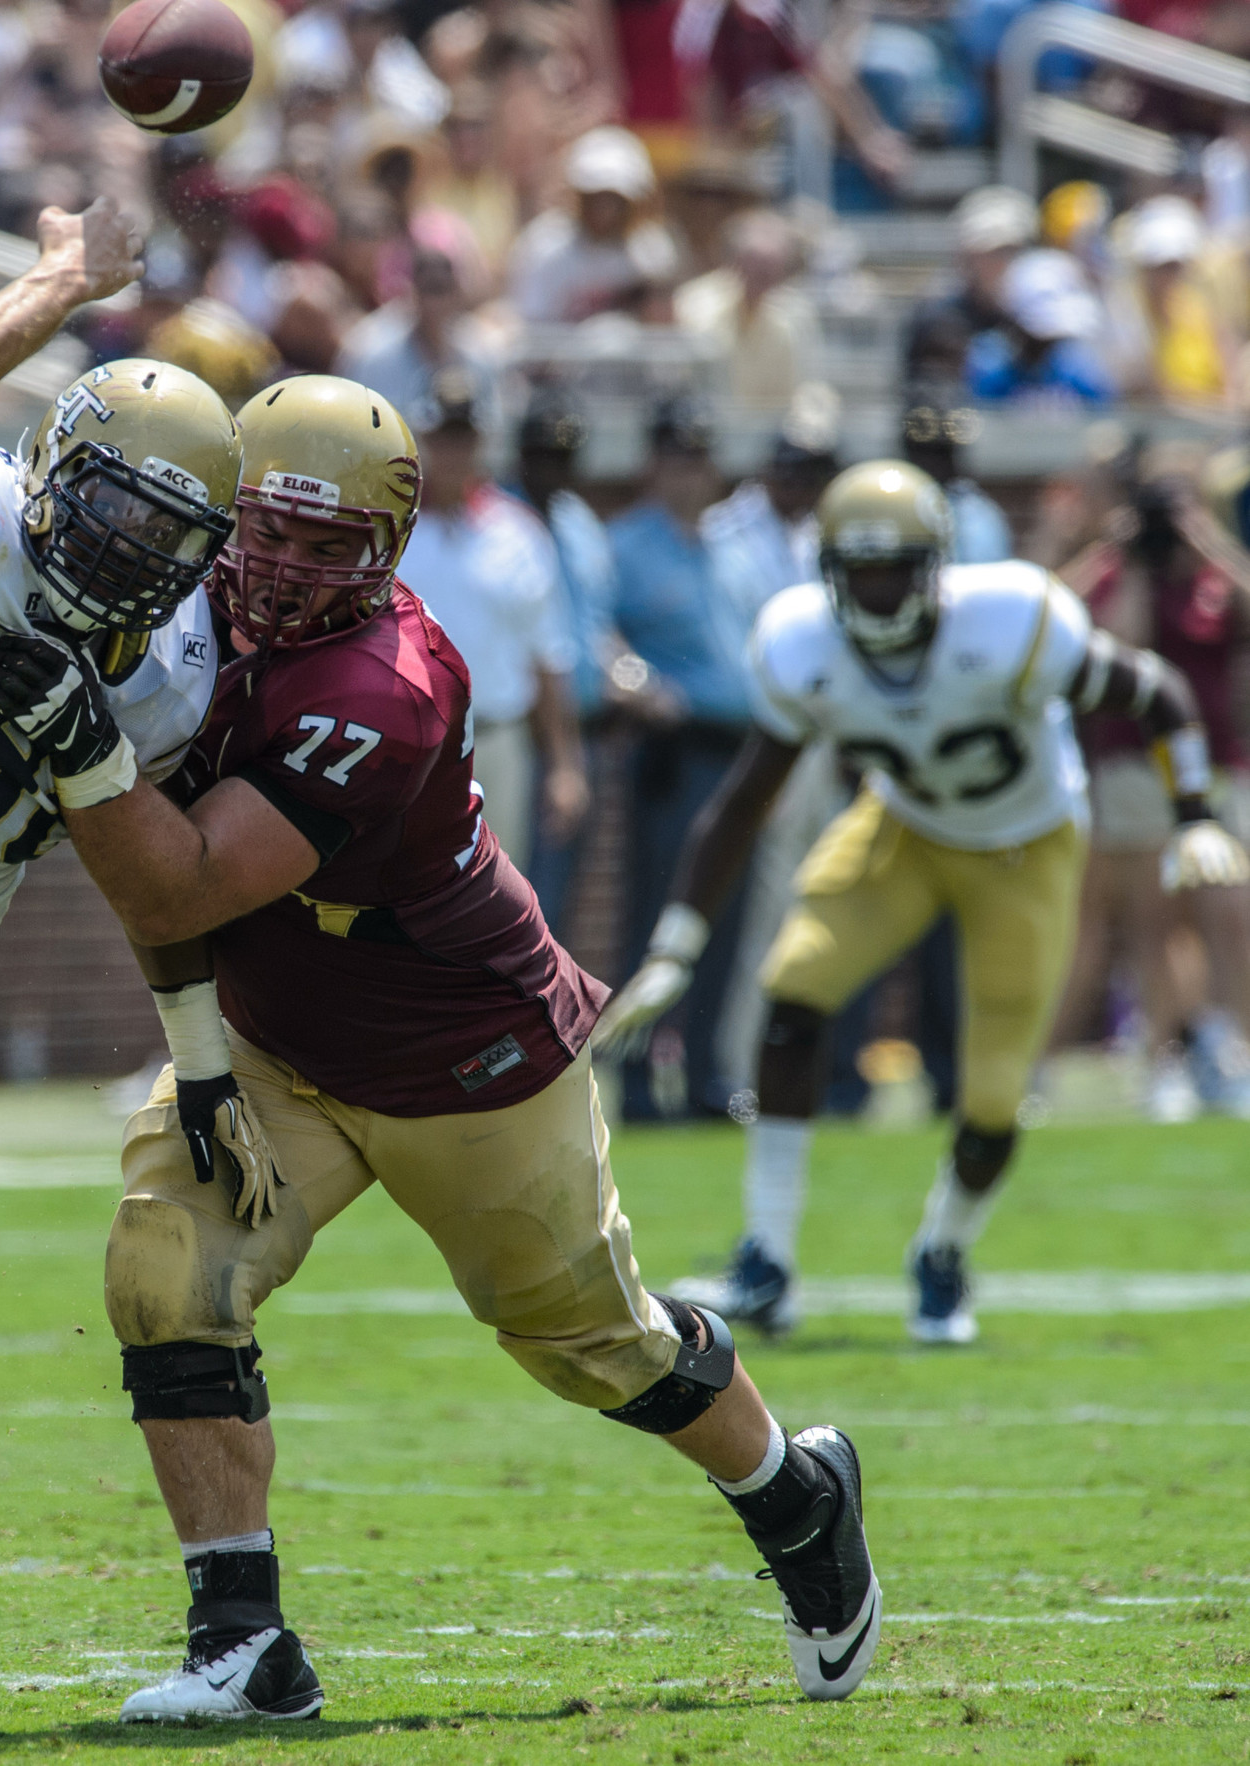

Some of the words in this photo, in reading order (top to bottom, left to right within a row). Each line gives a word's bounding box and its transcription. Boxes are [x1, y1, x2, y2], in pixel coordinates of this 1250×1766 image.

[160, 468, 192, 490] ACC
[282, 476, 322, 495] ELON
[185, 640, 206, 661] ACC
[282, 714, 382, 787] 77
[482, 1044, 512, 1067] XXL
